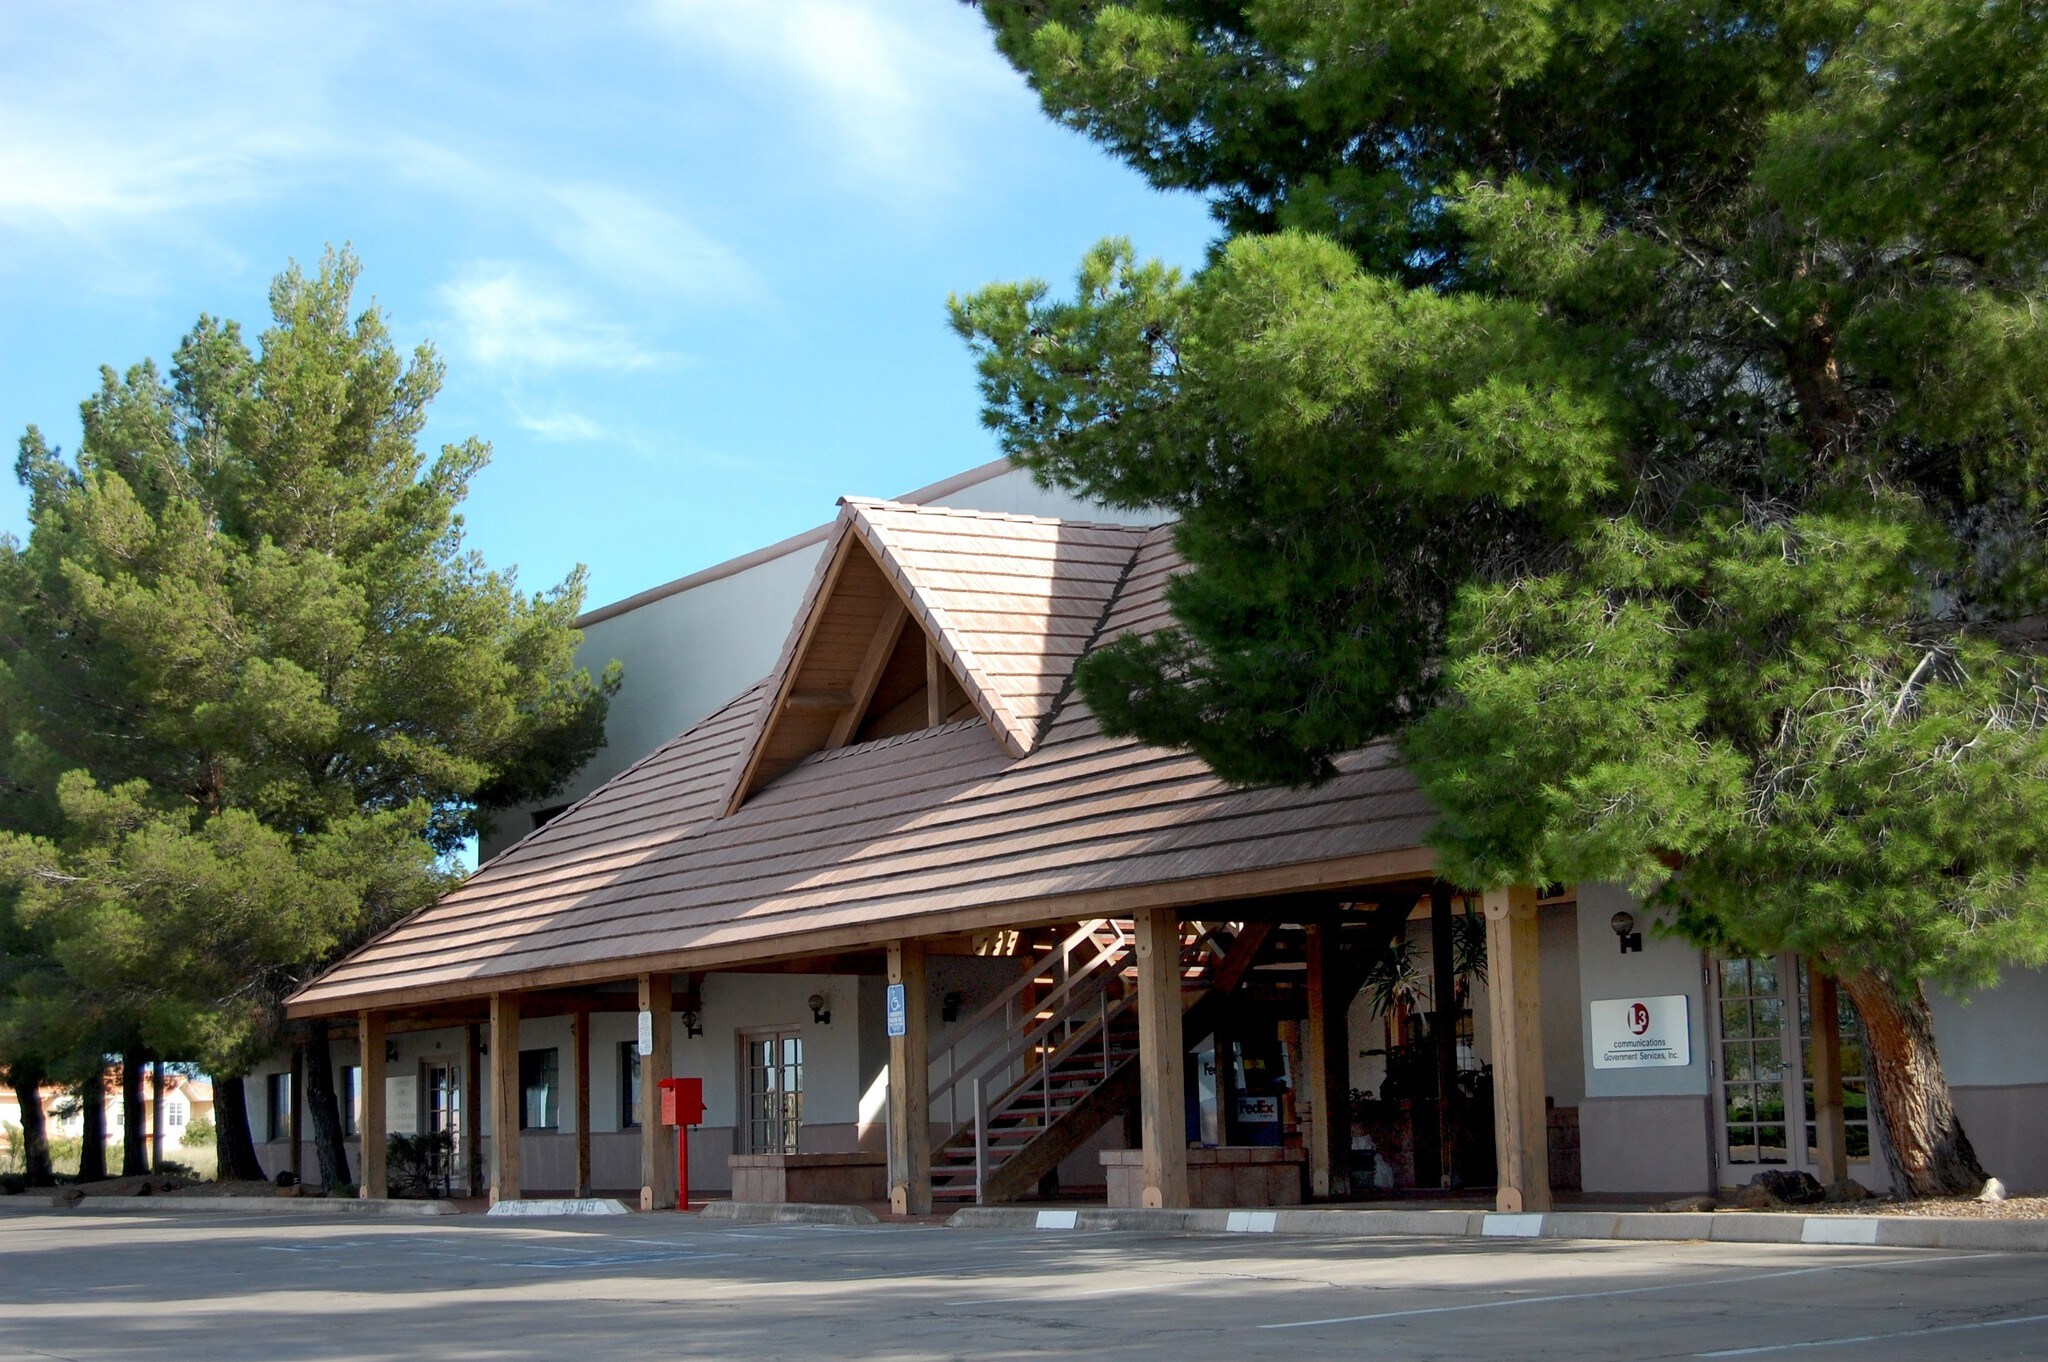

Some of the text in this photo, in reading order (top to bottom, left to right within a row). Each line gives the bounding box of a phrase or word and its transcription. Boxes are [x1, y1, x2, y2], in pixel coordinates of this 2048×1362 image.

[1629, 1006, 1647, 1032] L3
[1613, 1038, 1666, 1048] communications
[1603, 1051, 1680, 1061] Government Services, Inc.
[1239, 1099, 1274, 1114] FedEx
